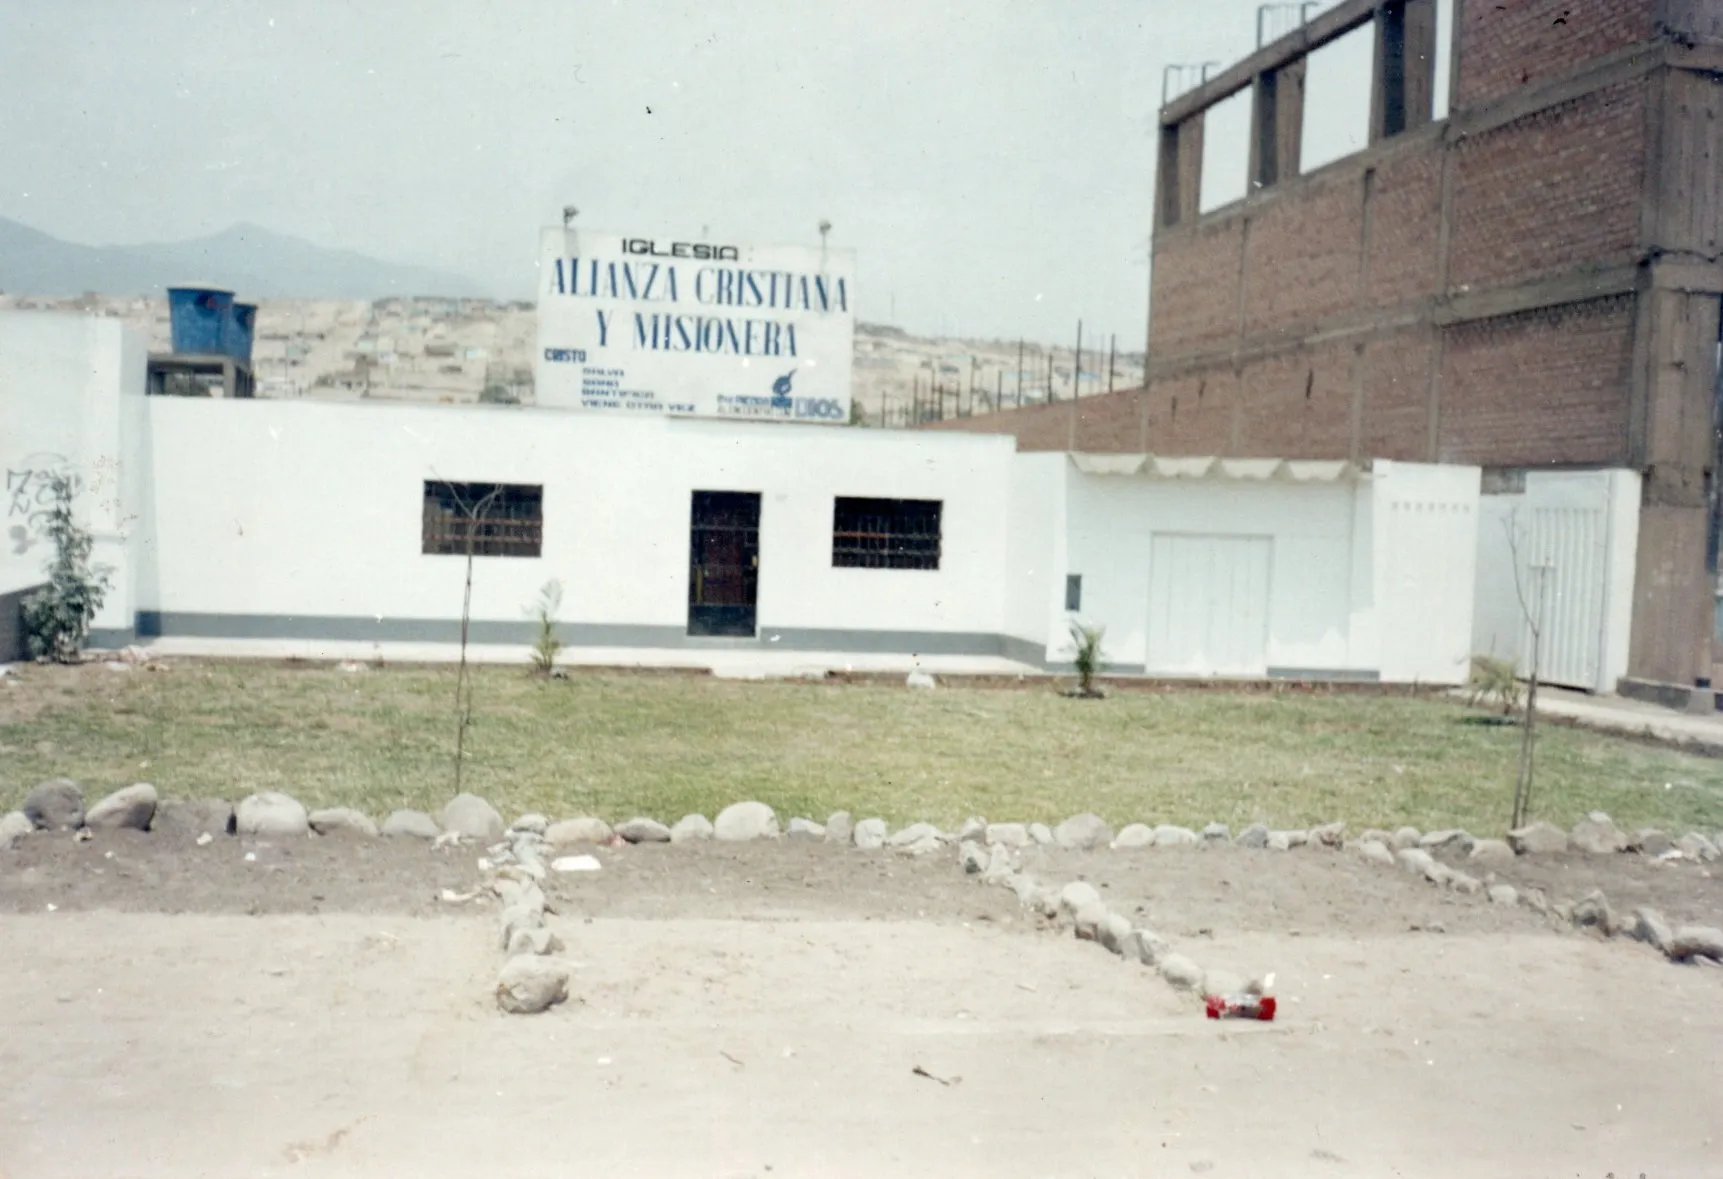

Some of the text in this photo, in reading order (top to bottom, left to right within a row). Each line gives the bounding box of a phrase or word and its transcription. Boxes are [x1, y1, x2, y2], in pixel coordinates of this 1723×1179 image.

[621, 238, 739, 261] IGLESIA
[549, 257, 849, 313] ALIANZA CRISTIANA
[596, 309, 797, 357] Y MISIONERA
